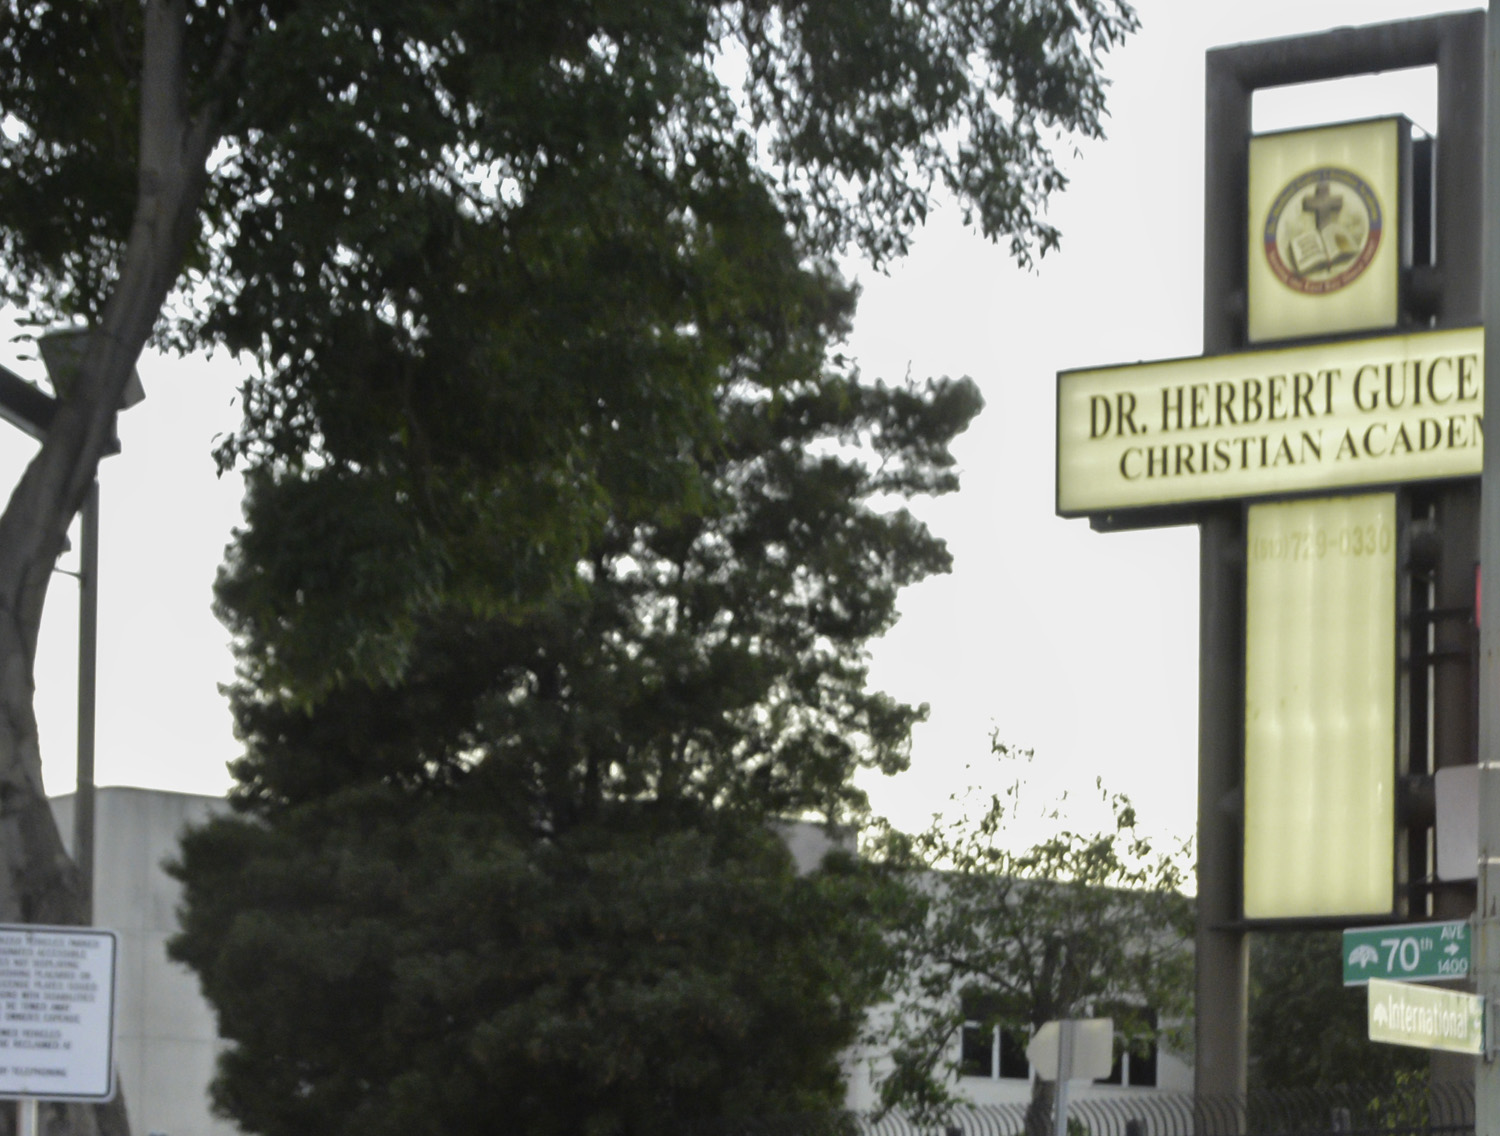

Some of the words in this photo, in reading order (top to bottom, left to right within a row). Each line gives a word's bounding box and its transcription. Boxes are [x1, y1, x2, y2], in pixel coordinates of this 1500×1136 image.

[1088, 392, 1147, 440] DR.
[1160, 368, 1342, 433] HERBERT
[1352, 353, 1479, 413] GUICE
[1118, 429, 1323, 482] CHRISTIAN
[1381, 936, 1434, 973] 70th
[1440, 925, 1466, 941] AVE
[1437, 957, 1469, 974] 1400
[1388, 994, 1469, 1039] International
